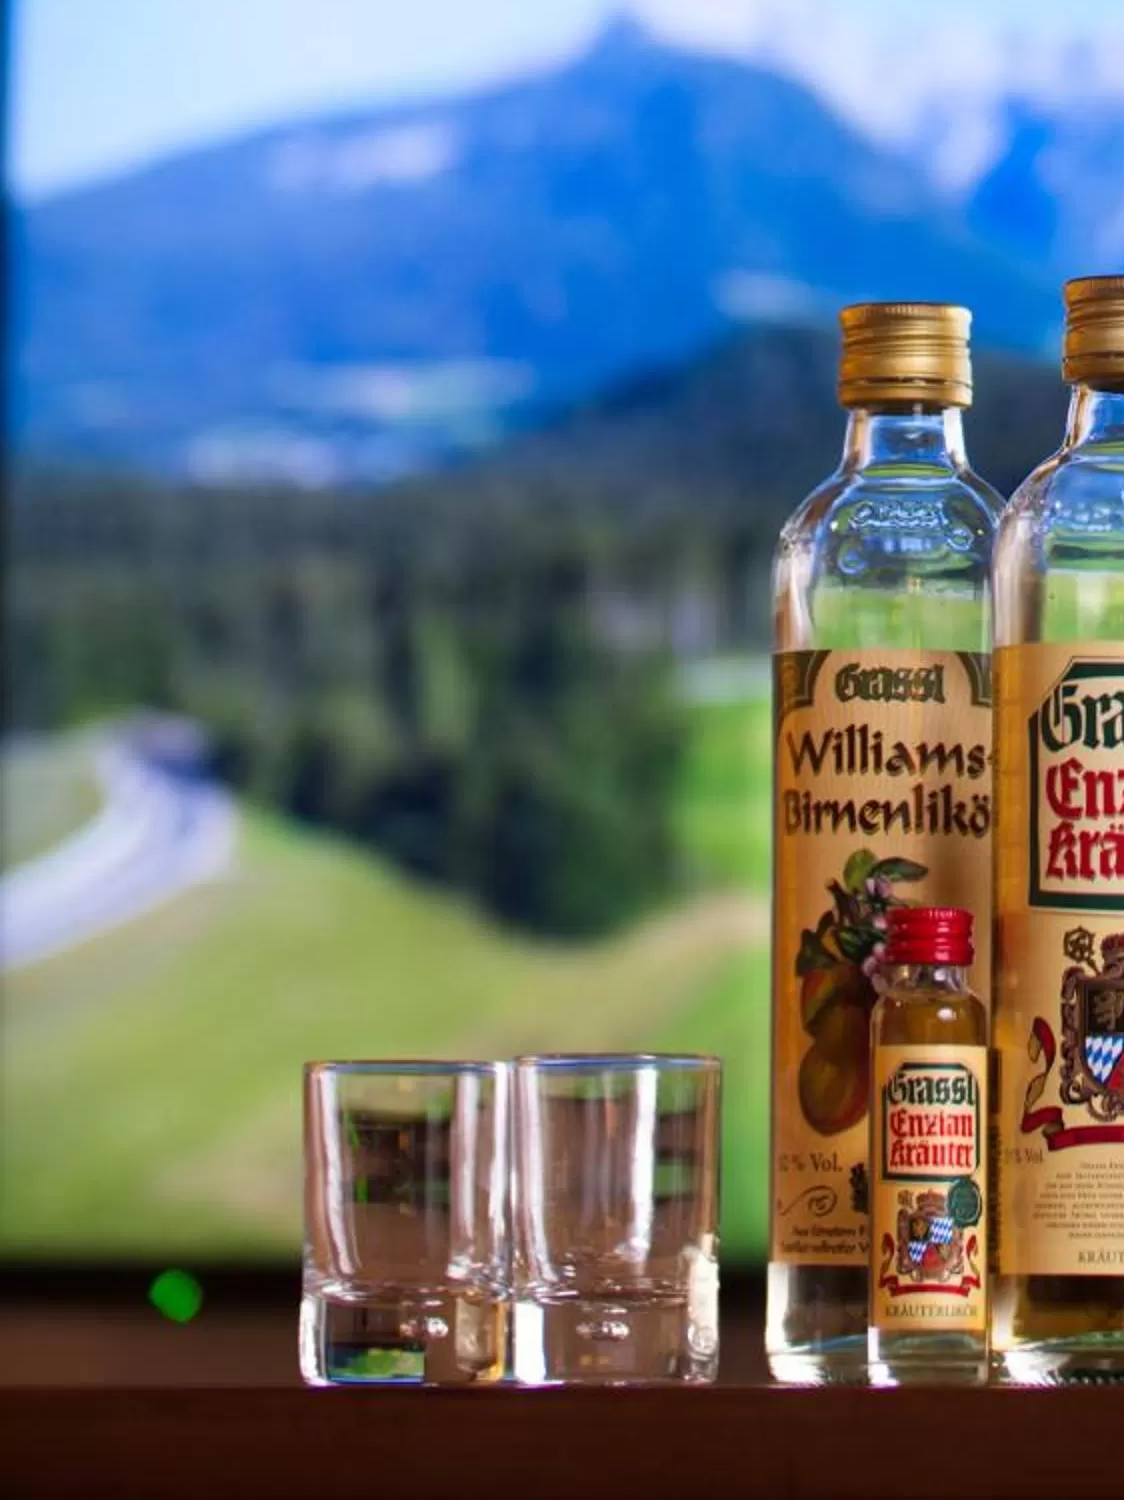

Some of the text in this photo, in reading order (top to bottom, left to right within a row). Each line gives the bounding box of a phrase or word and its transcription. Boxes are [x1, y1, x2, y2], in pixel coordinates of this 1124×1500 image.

[834, 662, 945, 704] Grassl
[887, 1072, 975, 1106] Grassl
[889, 1108, 973, 1138] Enzian
[810, 1149, 843, 1173] Vol.
[889, 1139, 973, 1169] Kräuter
